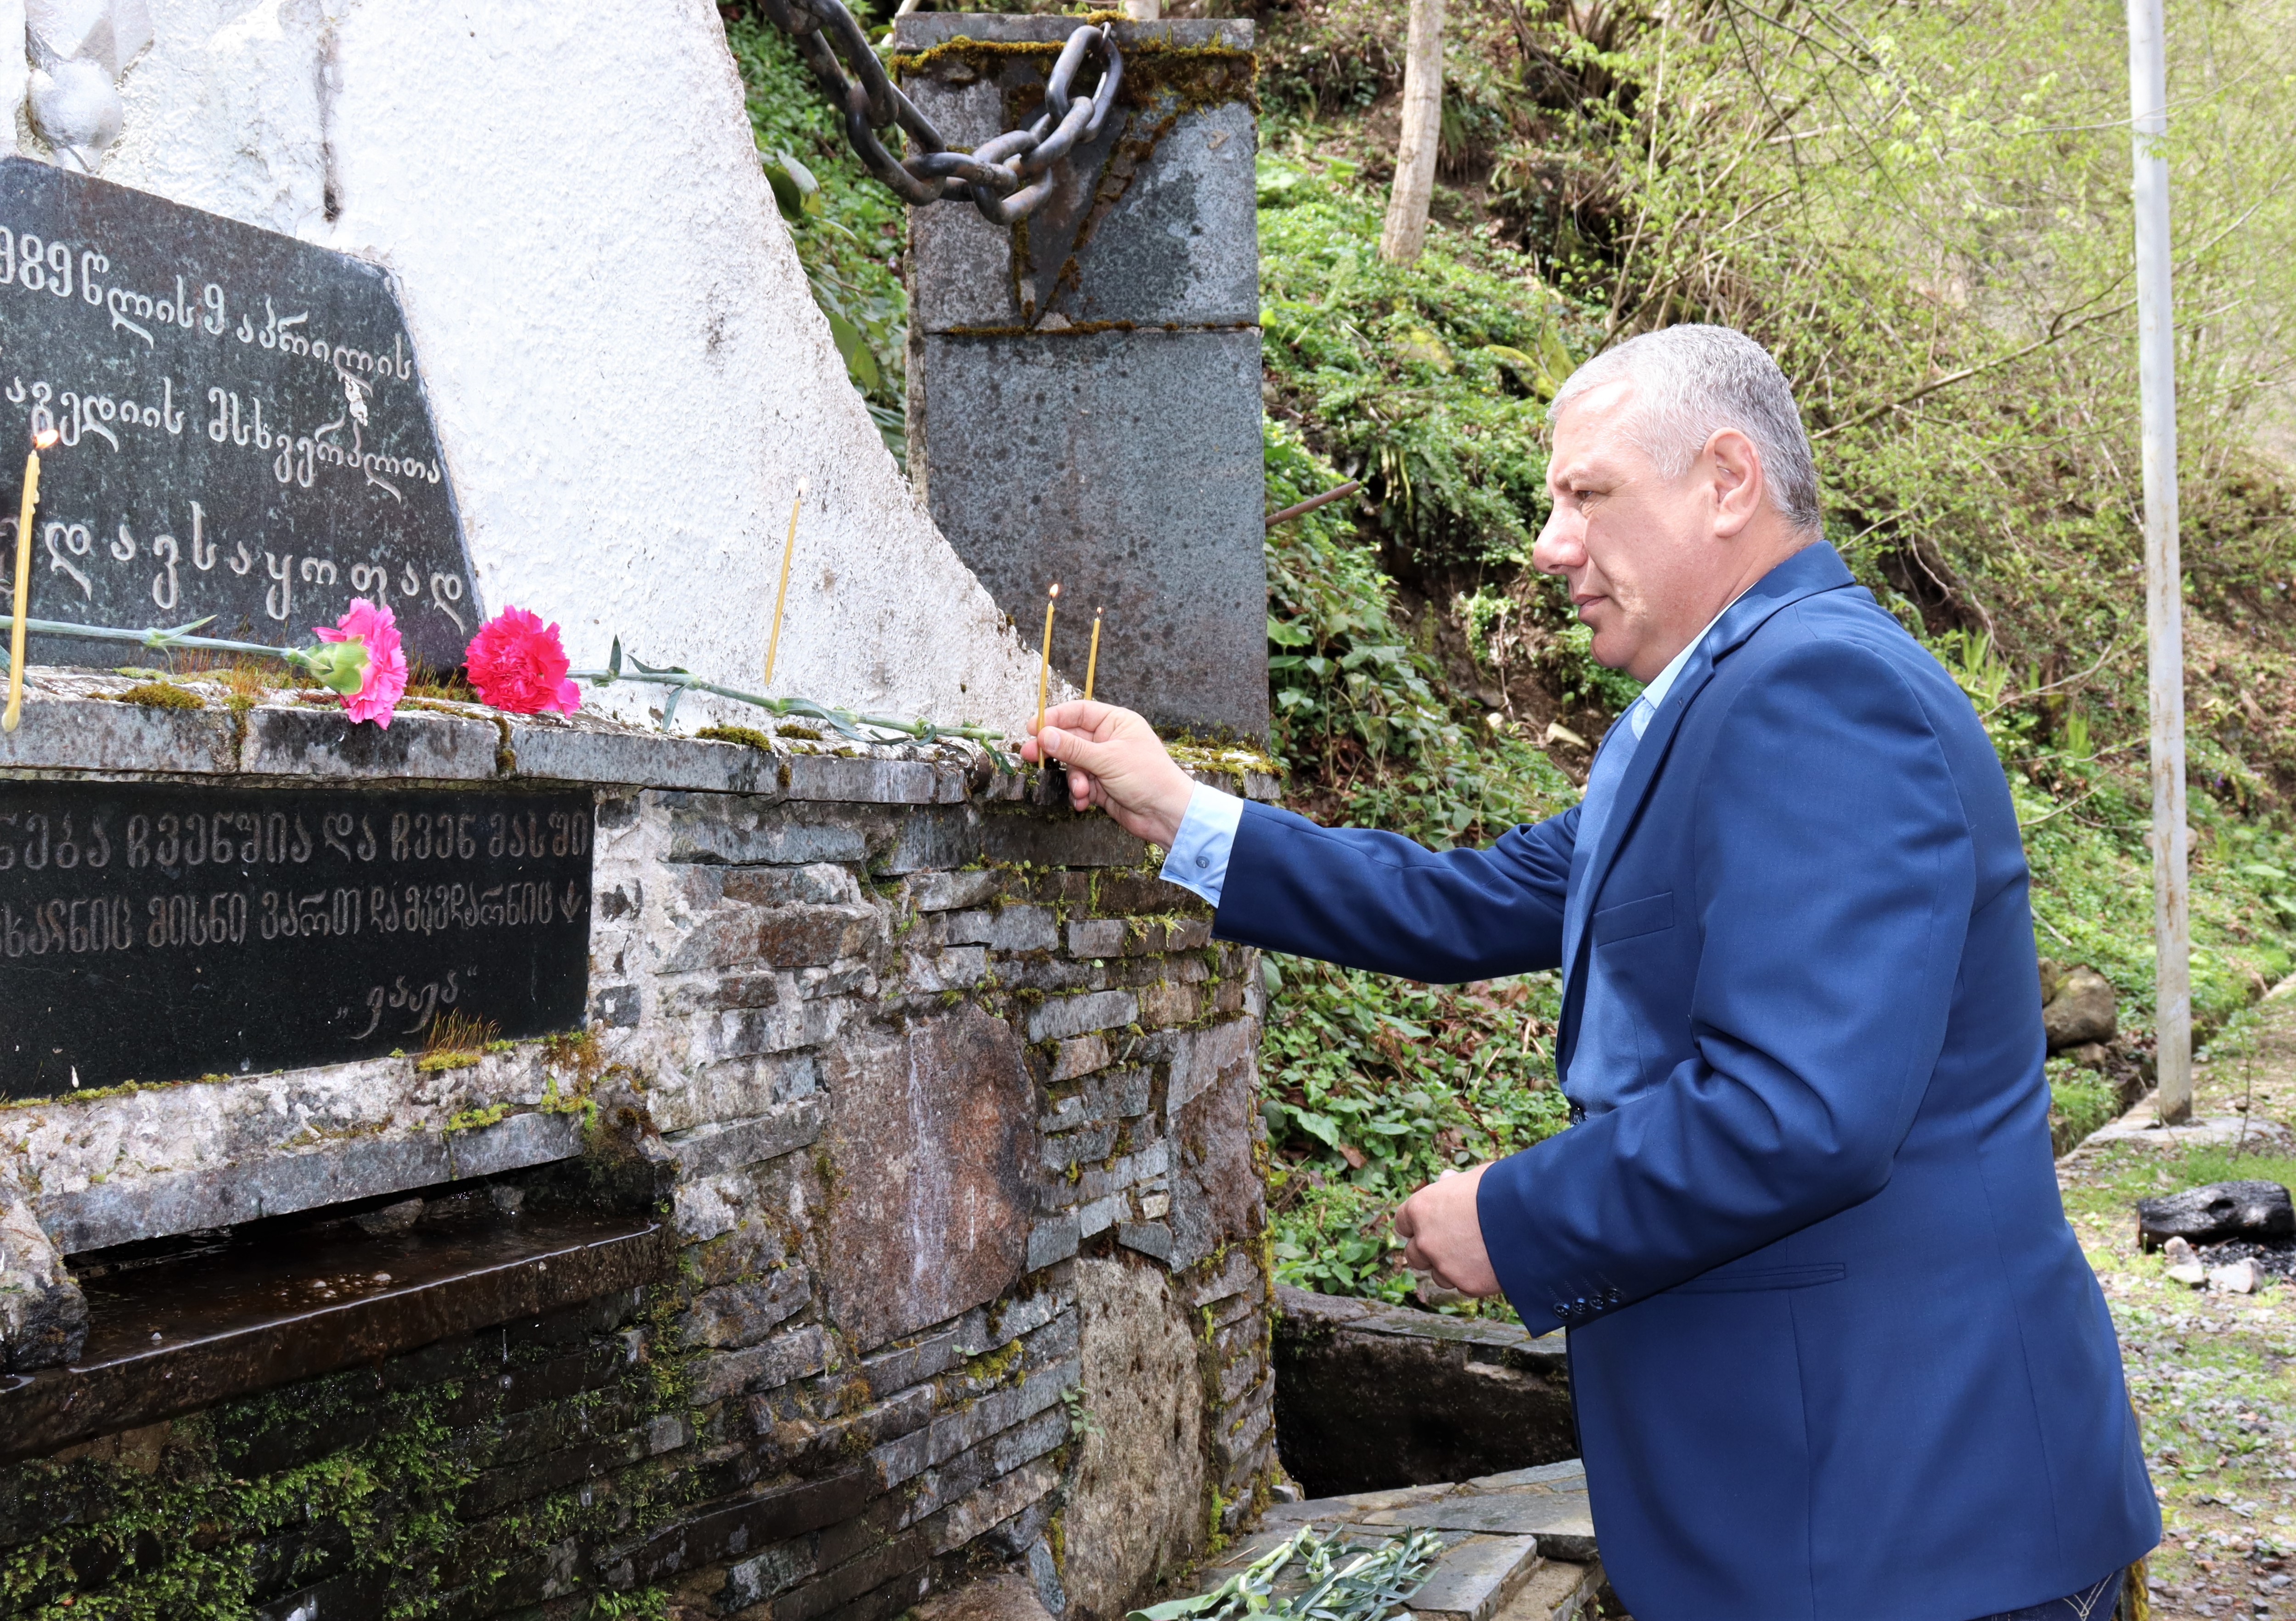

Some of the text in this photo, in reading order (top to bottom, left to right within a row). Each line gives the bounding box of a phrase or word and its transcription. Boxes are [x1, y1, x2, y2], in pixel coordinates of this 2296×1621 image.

[81, 250, 194, 350] წლის
[204, 283, 225, 335] 9
[236, 297, 411, 398] აპრილის
[0, 374, 441, 505] აგედიის მსხვერპლთა
[127, 812, 313, 868] ჩვენშია
[322, 812, 377, 863] და
[391, 812, 476, 862] ჩვენ
[488, 810, 588, 858] მასში
[1, 896, 133, 958] ხალნიც
[147, 892, 247, 947] მისნი
[260, 889, 361, 940] ვართ
